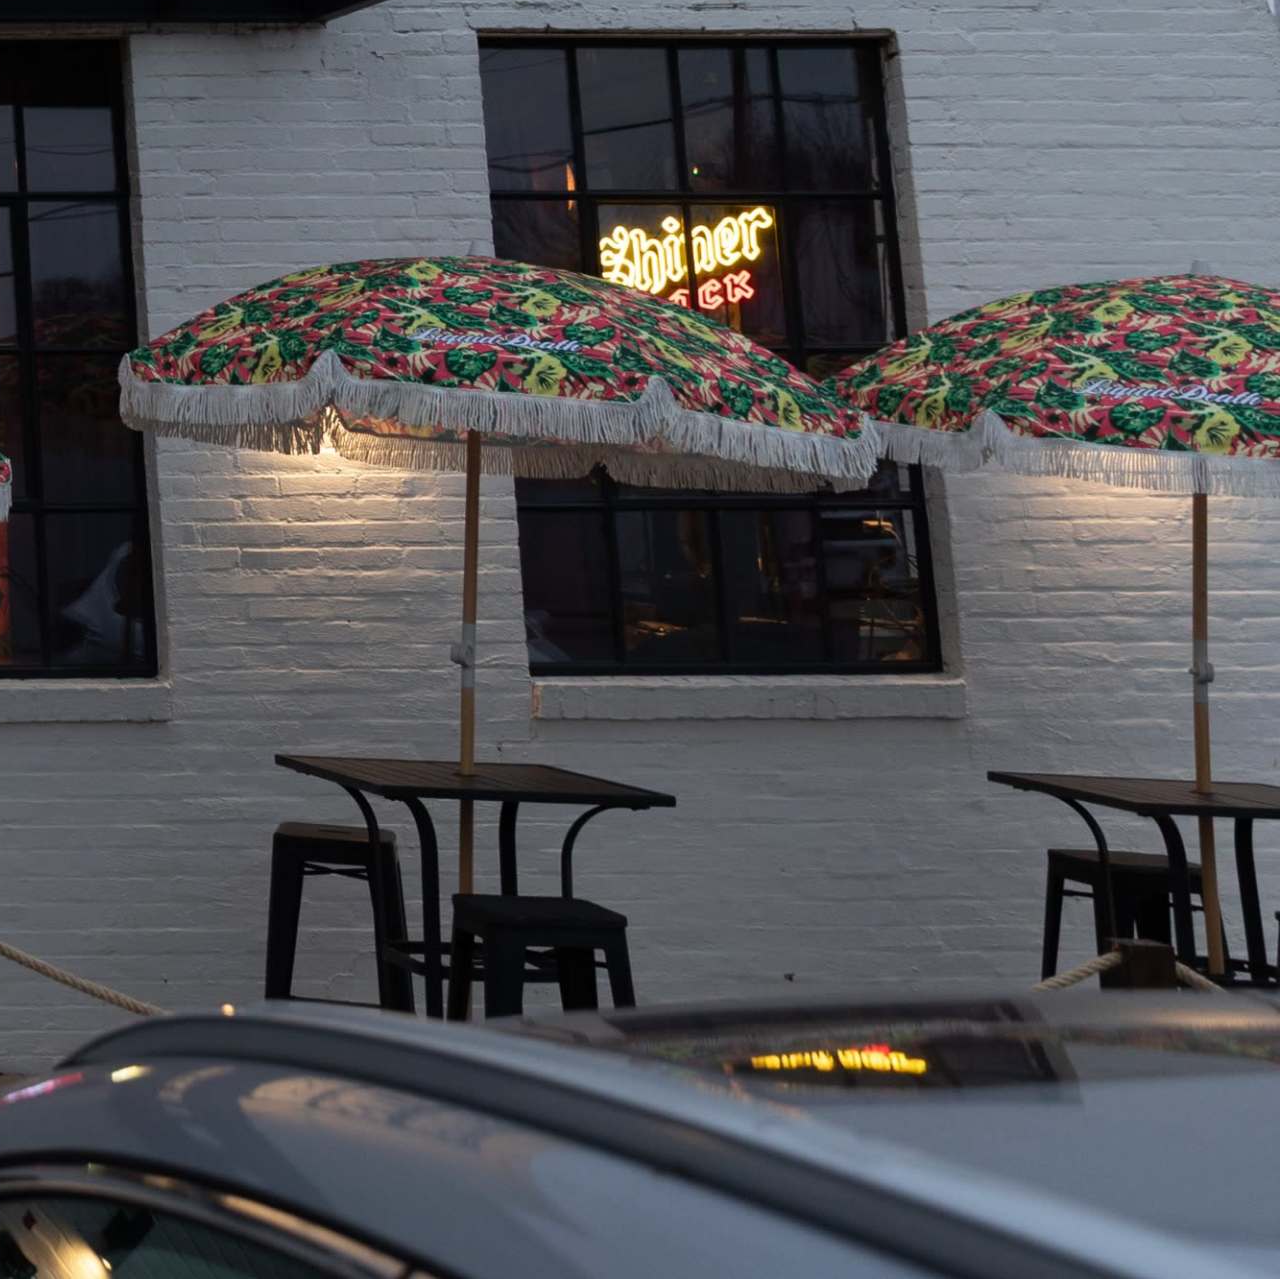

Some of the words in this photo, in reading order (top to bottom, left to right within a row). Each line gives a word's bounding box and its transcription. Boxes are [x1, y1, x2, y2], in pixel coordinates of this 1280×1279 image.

[599, 206, 773, 295] Shiner
[407, 327, 502, 346] Liquid
[503, 334, 583, 352] Death
[1074, 378, 1173, 399] Liquid
[1173, 385, 1263, 406] Death
